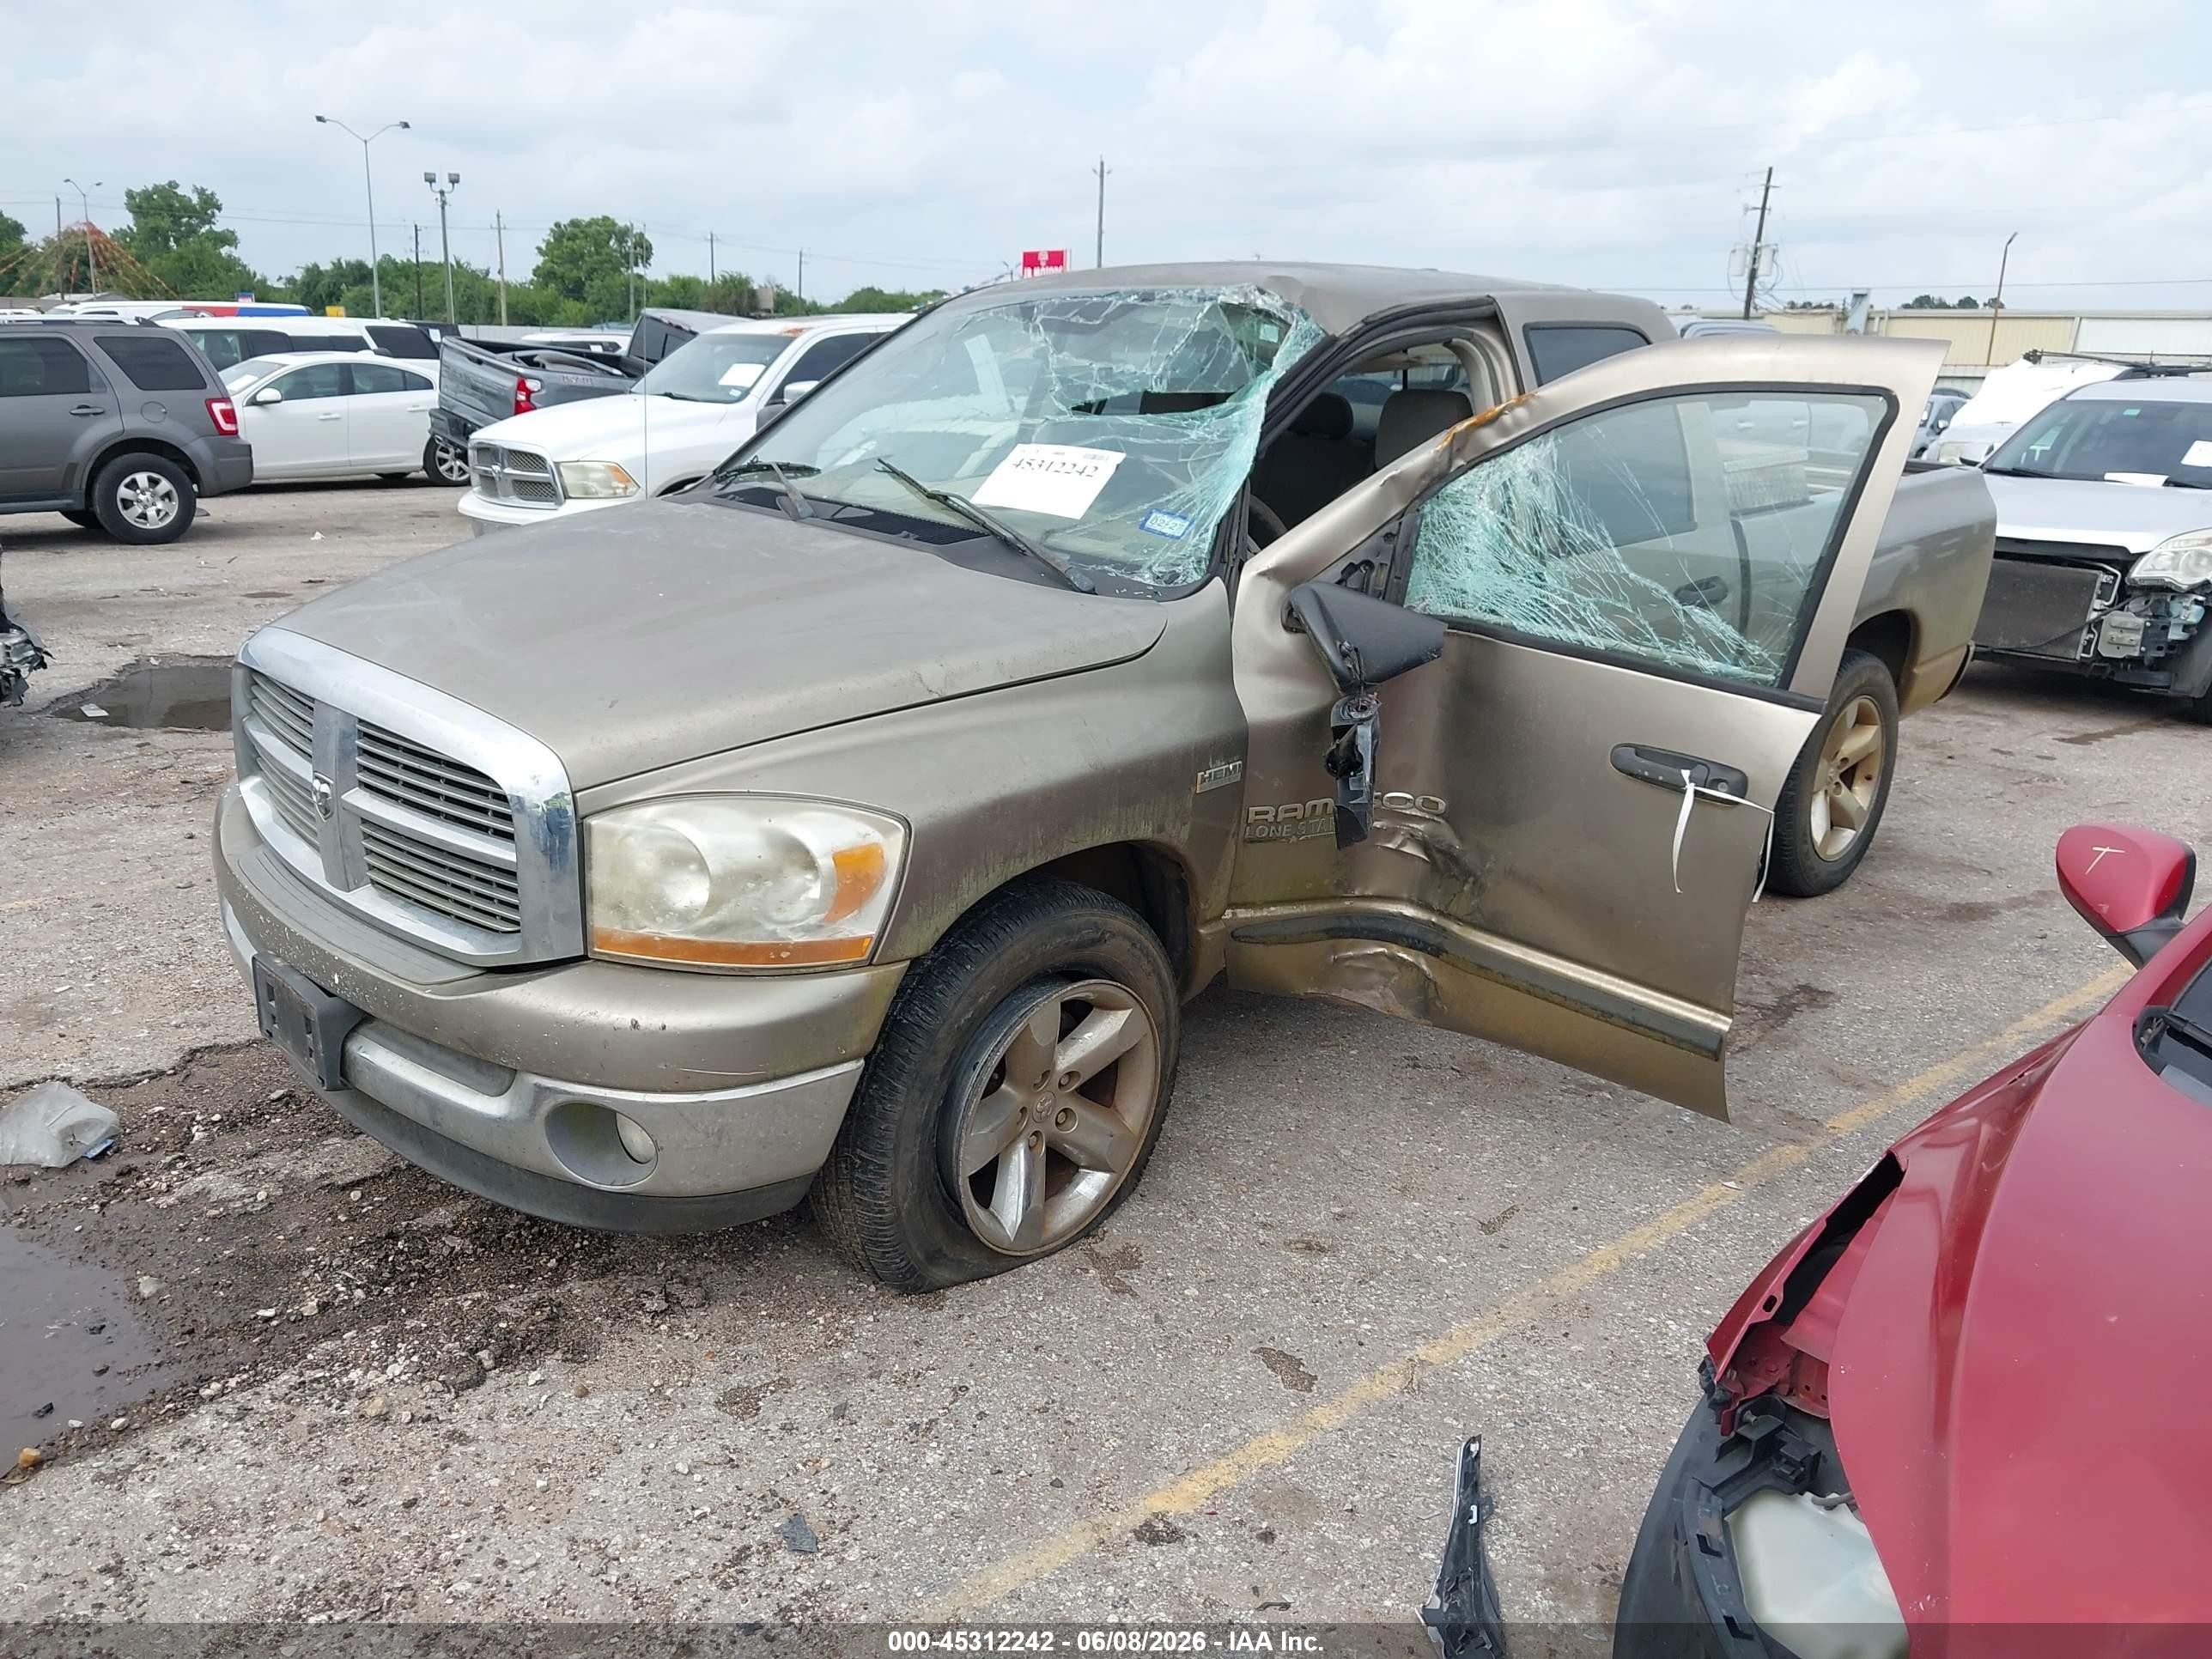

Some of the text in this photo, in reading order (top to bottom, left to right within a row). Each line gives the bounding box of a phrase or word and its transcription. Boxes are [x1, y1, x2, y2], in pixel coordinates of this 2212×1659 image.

[1012, 458, 1099, 478] 45312242
[1196, 761, 1243, 787] HEMI
[1247, 798, 1335, 824] RAM
[1245, 823, 1292, 840] LONE
